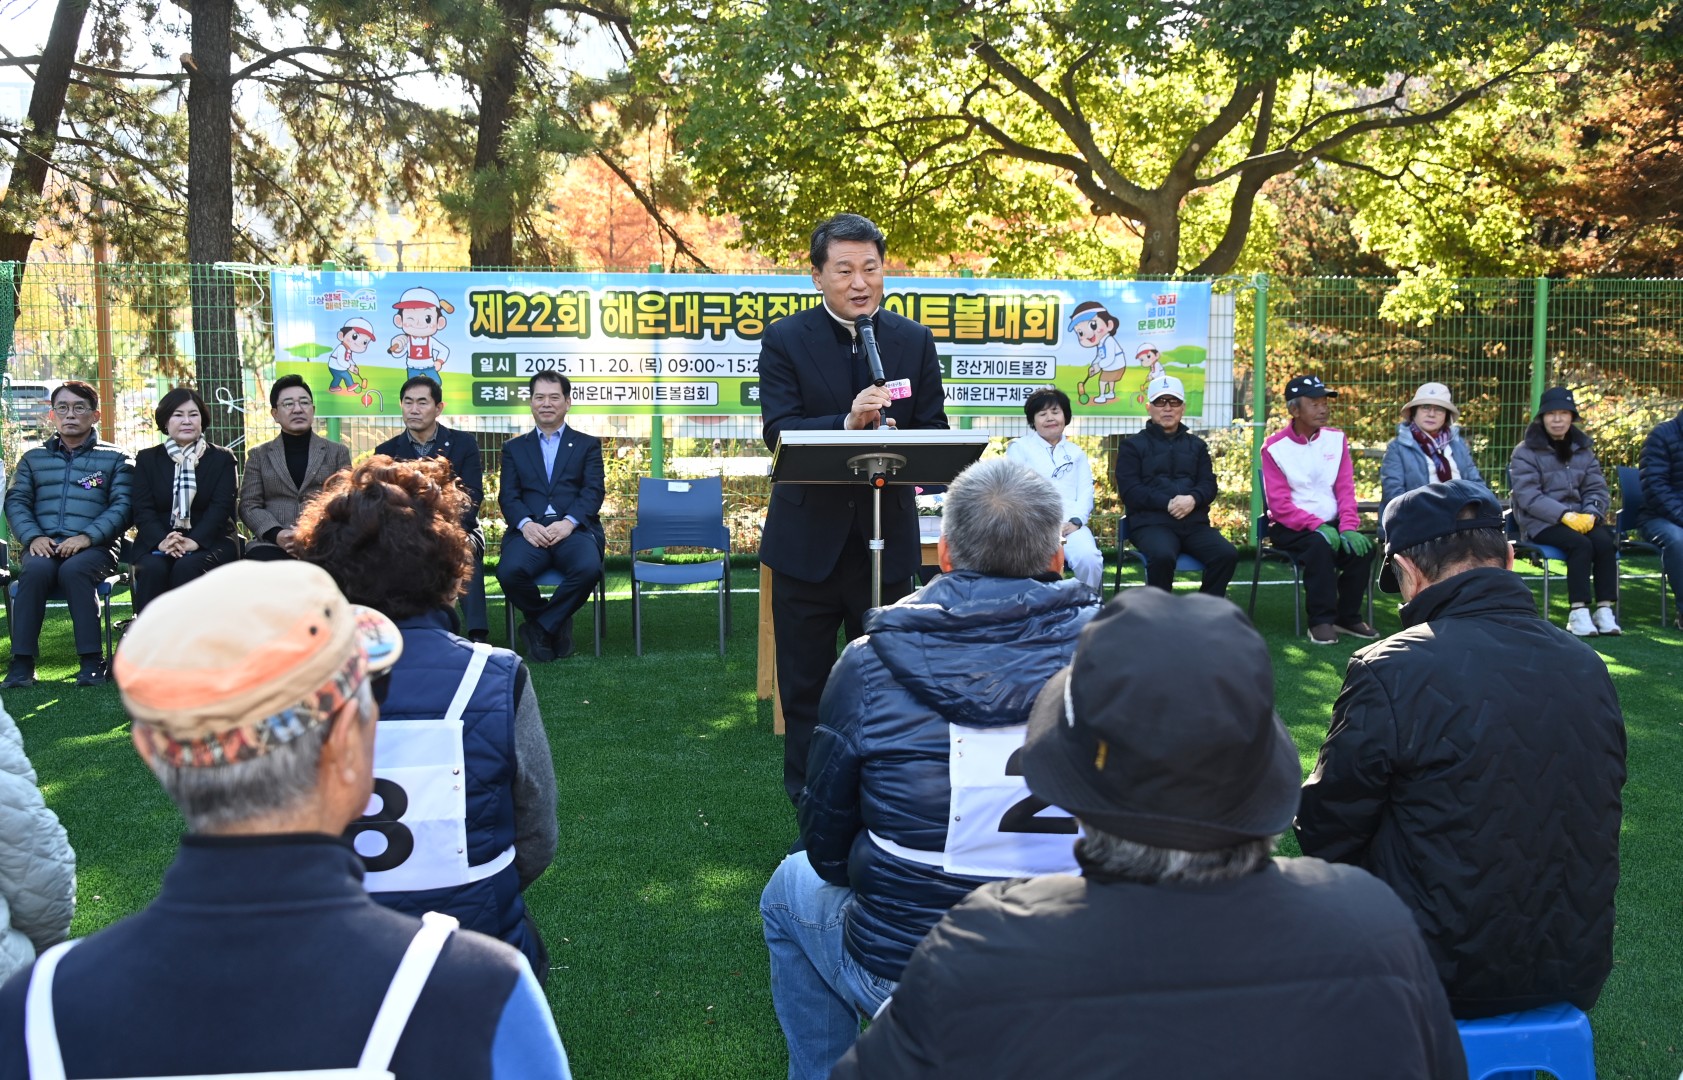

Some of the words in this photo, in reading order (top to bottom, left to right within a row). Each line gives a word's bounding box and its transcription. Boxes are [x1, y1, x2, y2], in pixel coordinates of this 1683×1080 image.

[472, 292, 587, 334] 제22회
[884, 295, 1055, 340] 이트볼대회
[416, 347, 423, 358] 2
[578, 358, 603, 373] 11.
[608, 358, 634, 374] 20.
[639, 358, 663, 374] (목)
[668, 358, 760, 374] 09:00~15:2
[956, 360, 1048, 376] 장산게이트볼장
[480, 386, 531, 401] 주최·주
[572, 386, 709, 401] 해운대구게이트볼협회
[944, 386, 1042, 402] 시해운대구체육
[998, 746, 1079, 835] 2
[341, 777, 415, 873] 8
